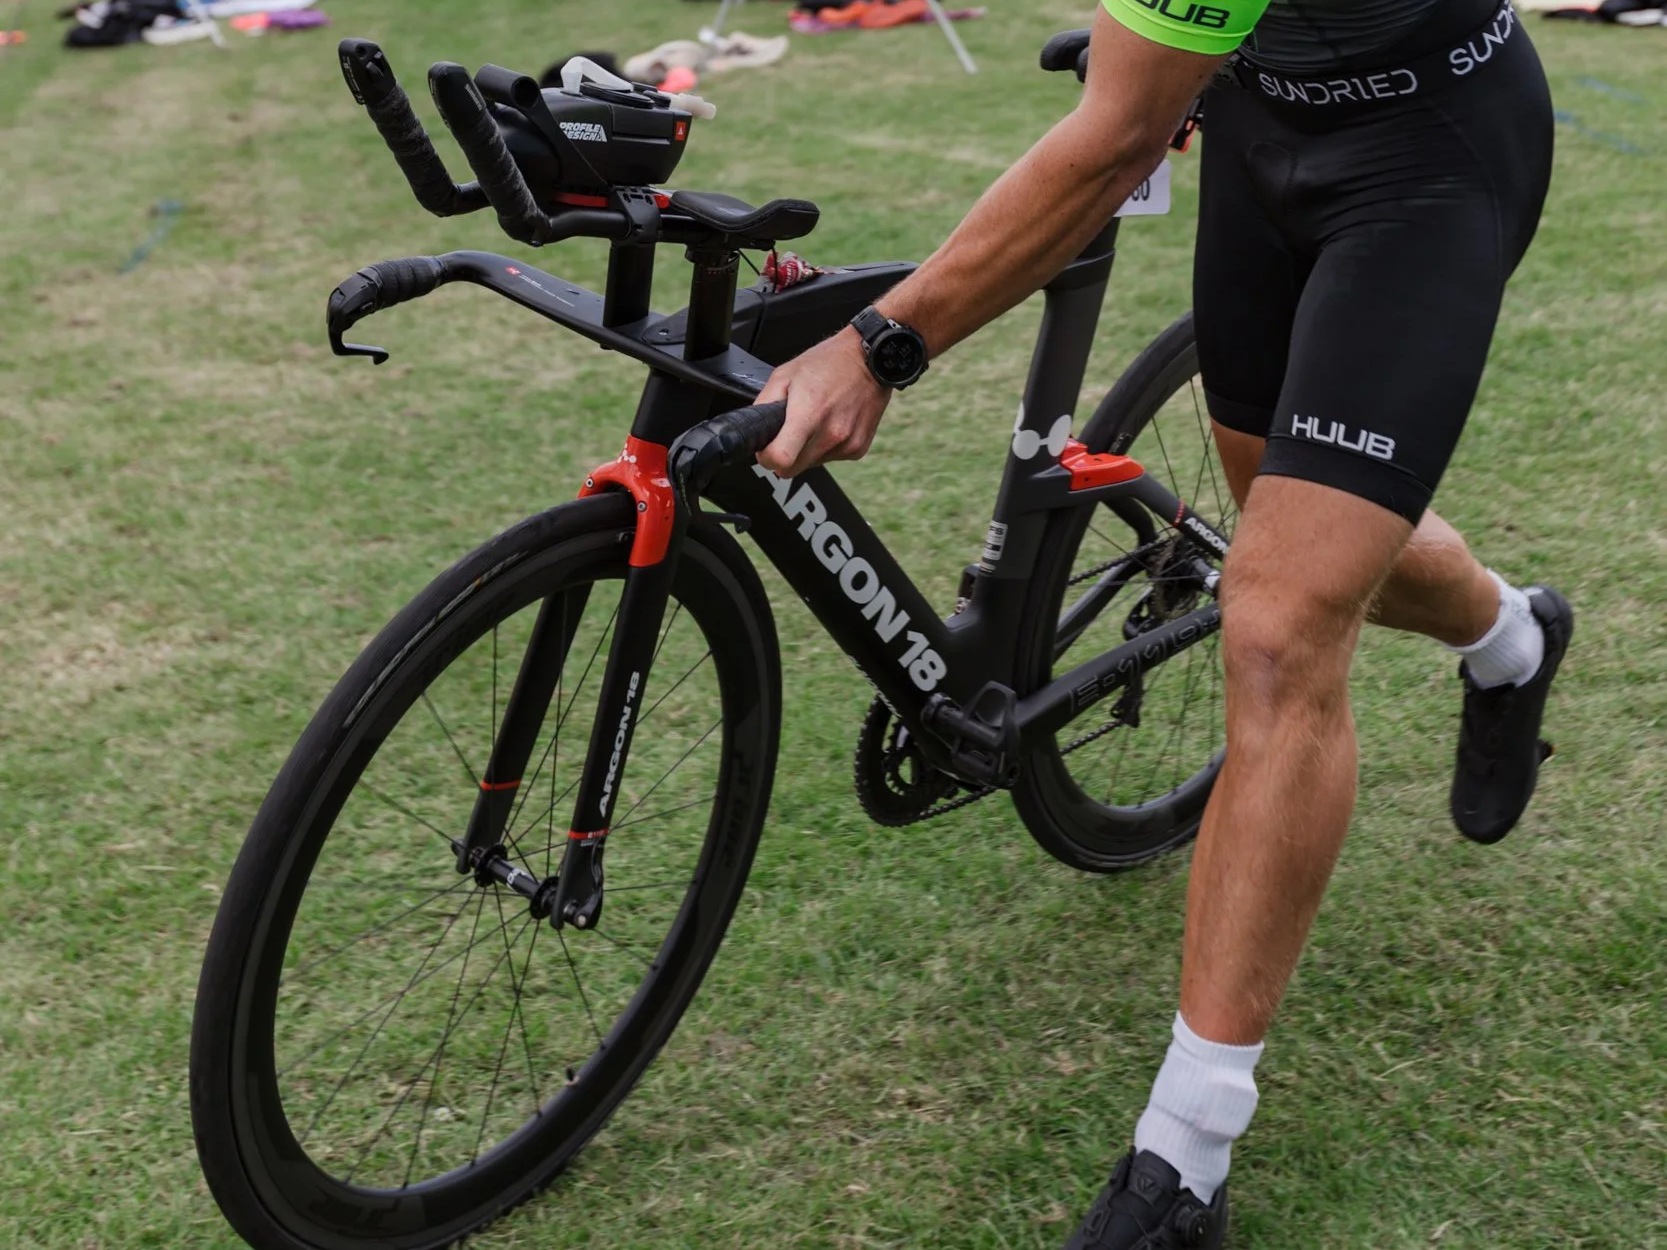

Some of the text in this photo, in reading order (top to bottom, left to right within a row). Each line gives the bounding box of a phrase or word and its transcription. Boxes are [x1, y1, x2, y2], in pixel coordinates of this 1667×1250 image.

[1258, 68, 1418, 105] SUNDRIED
[559, 121, 602, 132] PROFILE
[1291, 413, 1396, 461] HUUB
[1184, 516, 1230, 555] ARGON
[751, 463, 948, 693] ARGON 18
[599, 670, 640, 818] ARGON 18
